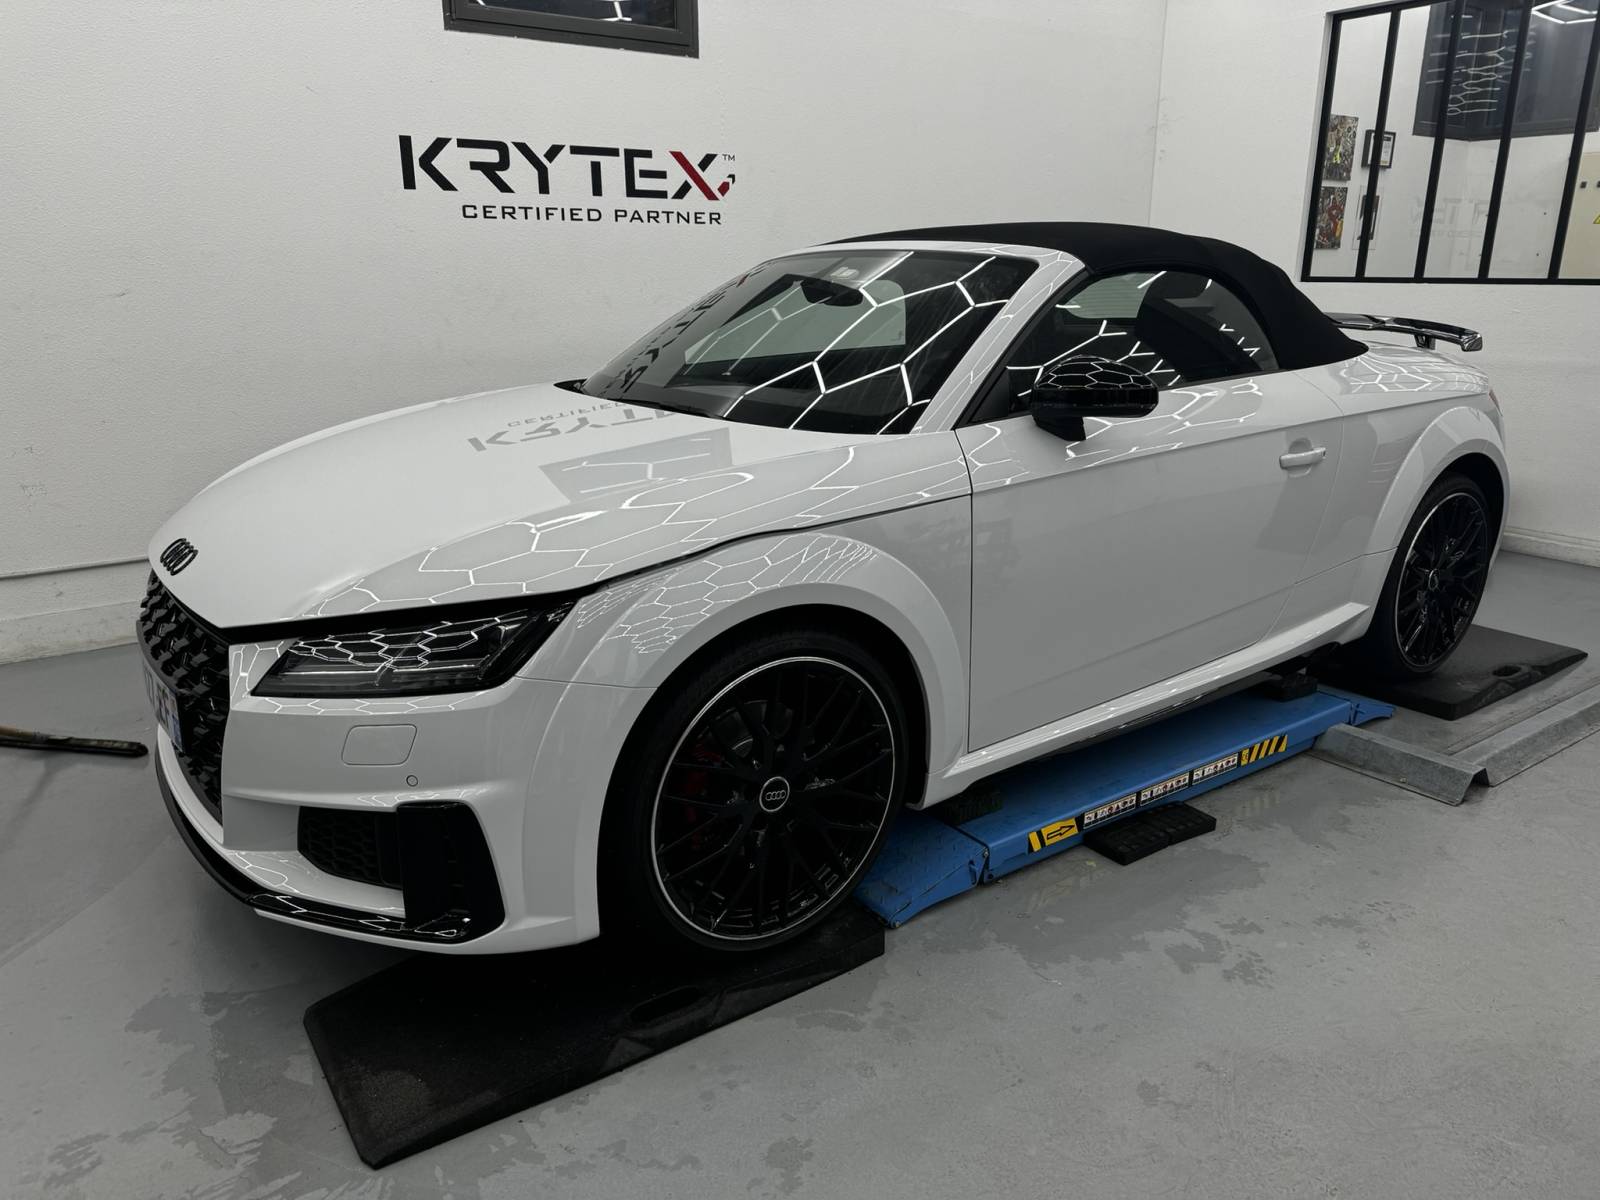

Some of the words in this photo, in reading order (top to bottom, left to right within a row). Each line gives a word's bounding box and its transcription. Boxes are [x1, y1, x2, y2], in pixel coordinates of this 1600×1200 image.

[398, 134, 735, 201] KRYTEX
[461, 204, 602, 222] CERTIFIED
[614, 208, 722, 225] PARTNER
